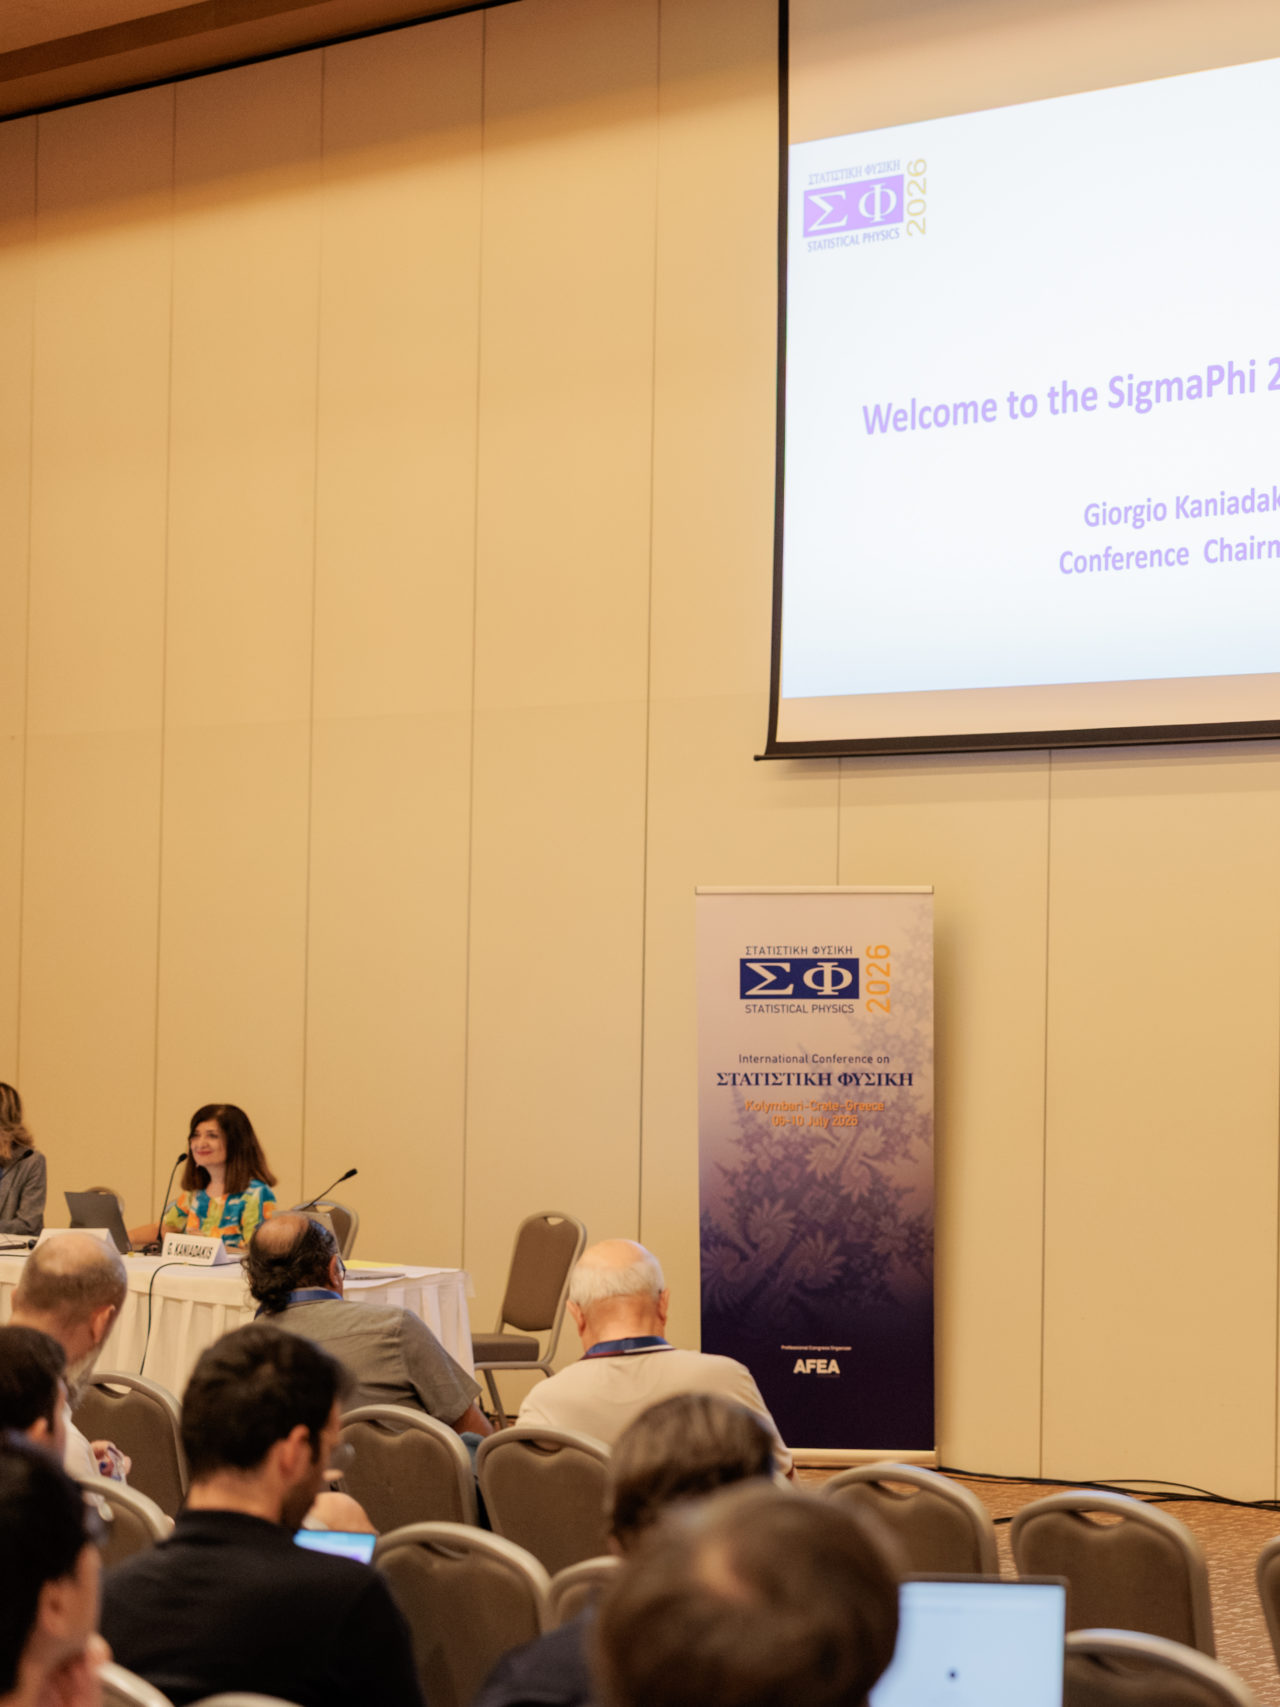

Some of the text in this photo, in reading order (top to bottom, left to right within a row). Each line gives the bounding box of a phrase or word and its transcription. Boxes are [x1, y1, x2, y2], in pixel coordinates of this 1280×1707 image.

[906, 158, 928, 237] 2026
[807, 227, 900, 253] STATISTICAL PHYSICS
[862, 398, 998, 436] Welcome
[1007, 391, 1038, 420] to
[1048, 380, 1099, 415] the
[1107, 359, 1257, 414] SigmaPhi
[1084, 498, 1168, 529] Giorgio
[1060, 546, 1190, 575] Conference
[745, 945, 853, 956] ΣΤΑΤΙΣΤΙΚΗ ΦΥΣΙΚΗ
[865, 944, 891, 1013] 2026
[745, 1004, 854, 1014] STATISTICAL PHYSICS
[738, 1054, 890, 1064] International Conference on
[716, 1072, 914, 1087] ΣΤΑΤΙΣΤΙΚΗ ΦΥΣΙΚΗ
[808, 1115, 829, 1129] July
[793, 1359, 841, 1374] AFEA
